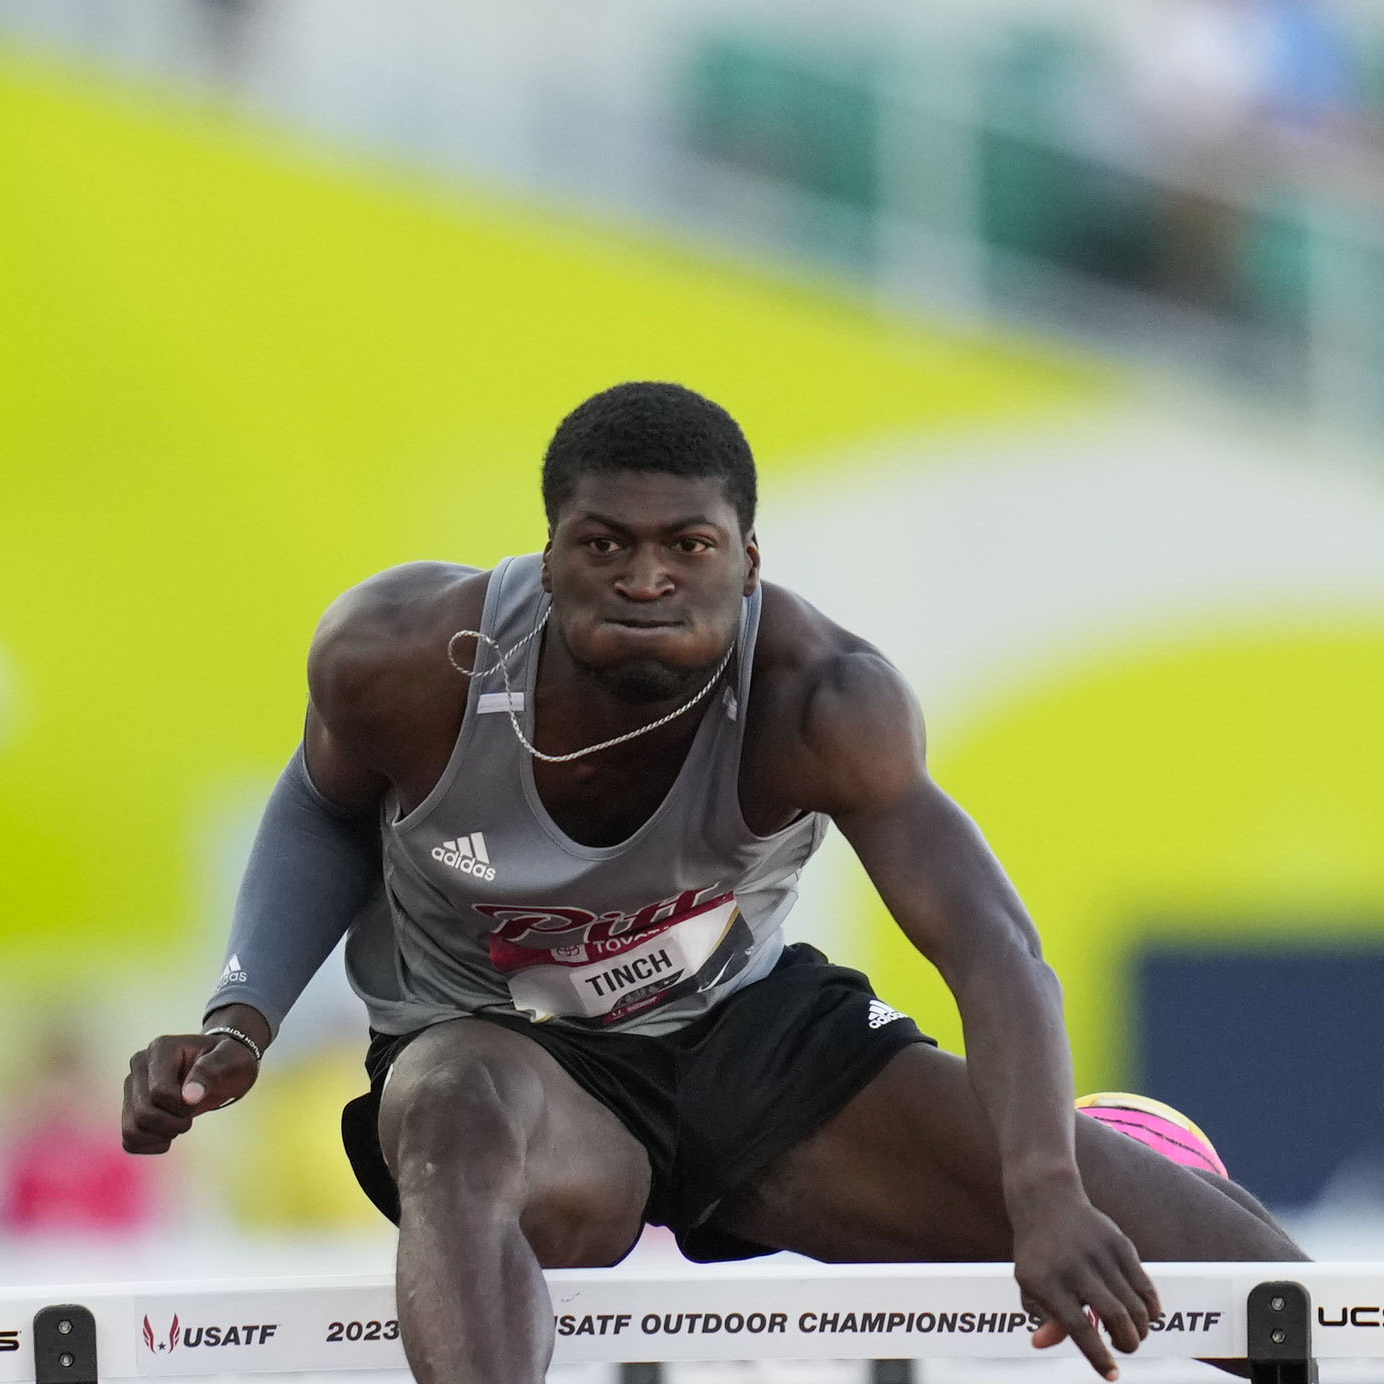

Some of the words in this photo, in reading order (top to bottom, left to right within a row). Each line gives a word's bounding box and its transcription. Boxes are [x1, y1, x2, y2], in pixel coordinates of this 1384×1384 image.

[430, 844, 497, 882] adidas
[584, 949, 674, 997] TINCH
[183, 1324, 278, 1348] USATF
[325, 1319, 401, 1342] 2023
[553, 1314, 633, 1337] SATF
[641, 1312, 788, 1335] OUTDOOR
[798, 1311, 1042, 1334] CHAMPIONSHIPS
[1147, 1311, 1222, 1332] SATF
